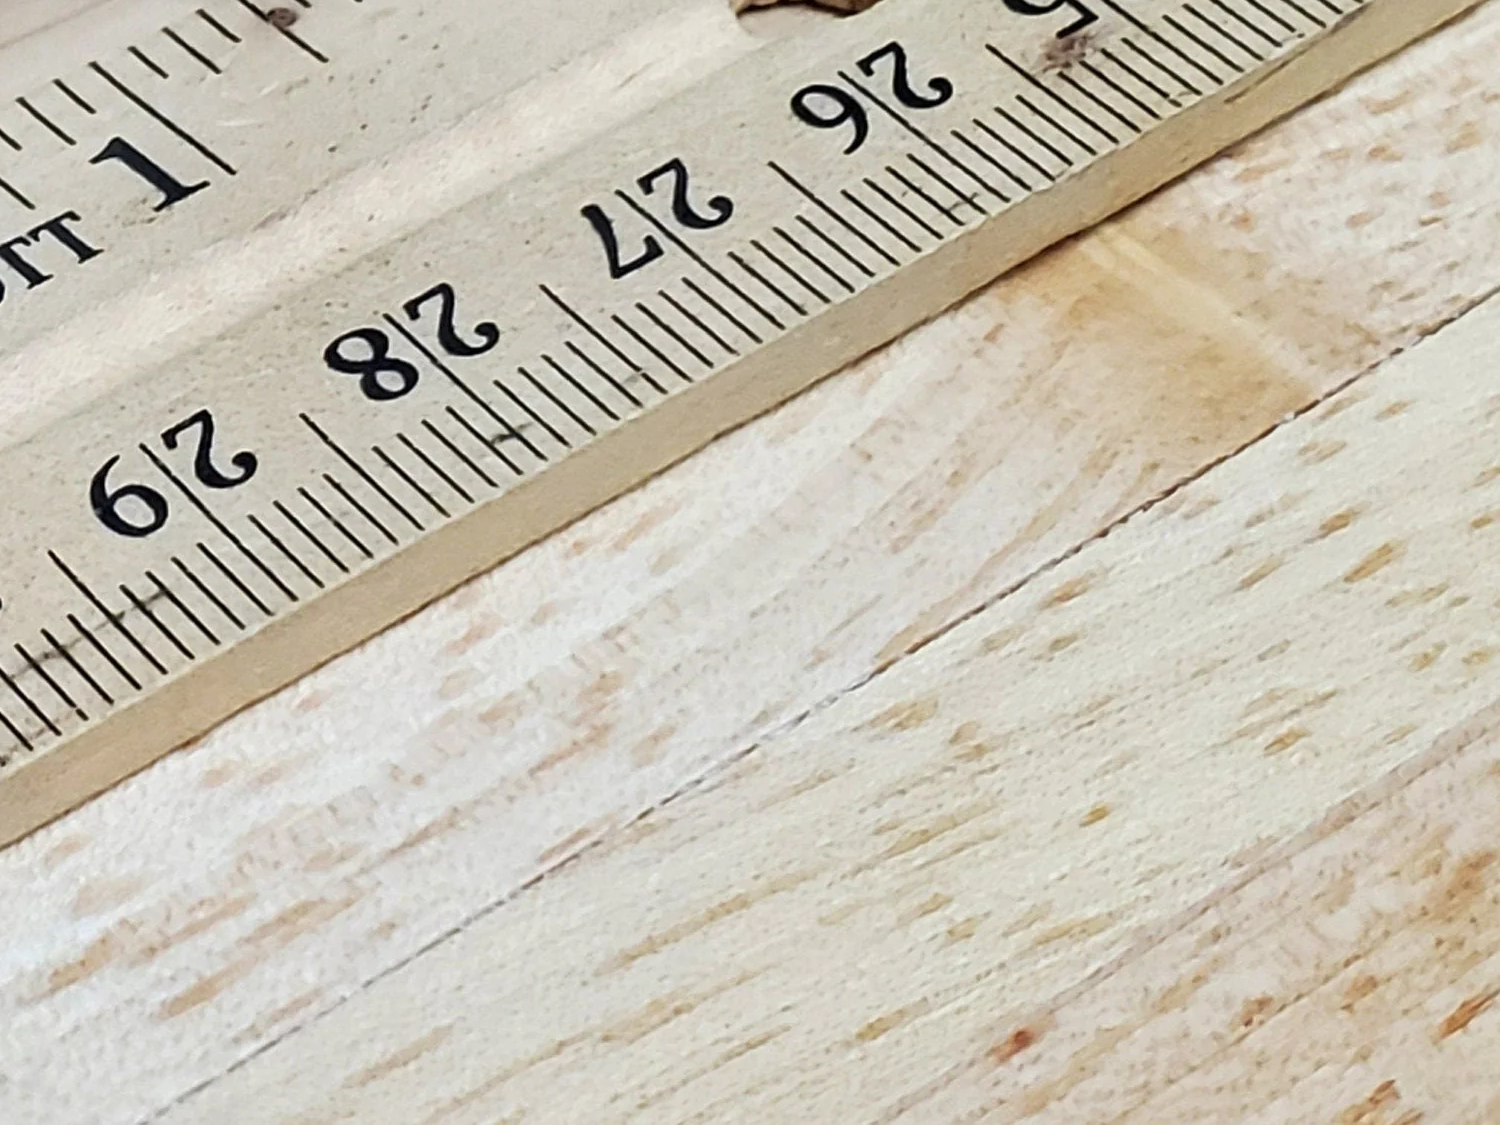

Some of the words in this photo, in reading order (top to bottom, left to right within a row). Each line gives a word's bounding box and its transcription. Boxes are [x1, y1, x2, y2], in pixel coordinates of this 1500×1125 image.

[790, 41, 953, 155] 26
[88, 136, 211, 212] 1
[580, 157, 733, 279] 27
[323, 282, 500, 401] 28
[89, 409, 258, 537] 29
